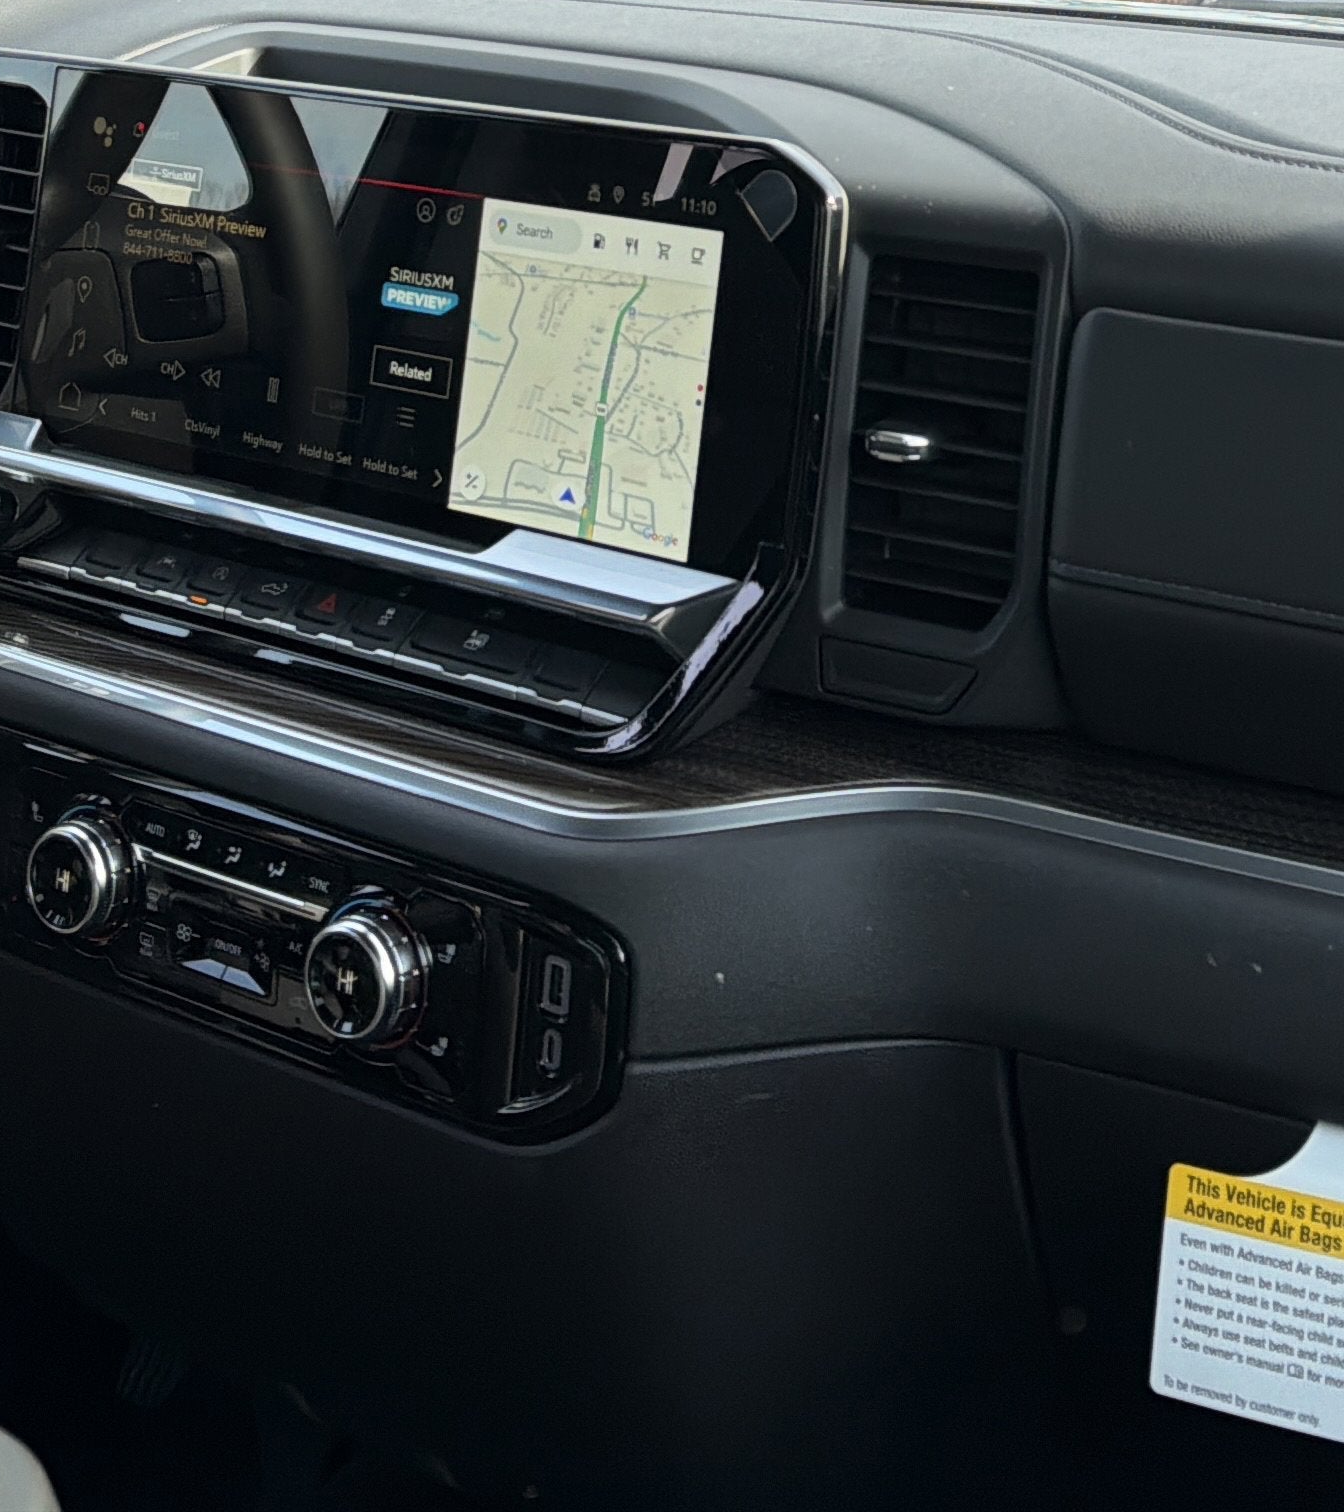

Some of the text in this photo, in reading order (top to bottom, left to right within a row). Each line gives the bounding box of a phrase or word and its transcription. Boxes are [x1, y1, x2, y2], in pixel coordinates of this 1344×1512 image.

[681, 197, 717, 216] 11:10
[127, 202, 145, 220] Ch
[159, 207, 214, 231] SiriusXM
[217, 216, 267, 239] Preview
[516, 223, 553, 240] Search
[125, 224, 153, 240] Great
[156, 229, 180, 245] Offer
[387, 288, 450, 310] PREVIEW
[161, 363, 174, 376] CH
[389, 360, 432, 382] Related
[131, 407, 149, 421] Hits
[242, 431, 283, 452] Highway
[299, 443, 322, 460] Hold
[336, 452, 352, 466] Set
[363, 457, 386, 474] Hold
[401, 466, 419, 481] Set
[643, 526, 678, 547] Google
[145, 822, 165, 838] AUTO
[309, 876, 330, 894] SYNC
[1187, 1175, 1220, 1199] This
[1226, 1183, 1286, 1215] Vehicle
[1291, 1199, 1305, 1219] is
[1184, 1198, 1343, 1252] Advanced Air Bags
[1180, 1233, 1344, 1285] Even with Advanced Air Bags
[1188, 1259, 1232, 1280] Children
[1235, 1273, 1255, 1287] can
[1258, 1276, 1272, 1290] be
[1275, 1280, 1306, 1299] killed
[1309, 1290, 1320, 1301] or
[1186, 1278, 1204, 1294] The
[1208, 1284, 1232, 1300] back
[1236, 1292, 1258, 1306] seat
[1272, 1300, 1289, 1315] the
[1292, 1306, 1324, 1323] safest
[1184, 1298, 1214, 1316] Never
[1217, 1307, 1234, 1321] put
[1246, 1315, 1305, 1341] rear-facing
[1307, 1329, 1334, 1345] child
[1182, 1318, 1218, 1338] Always
[1222, 1330, 1241, 1344] use
[1243, 1334, 1266, 1349] seat
[1268, 1339, 1295, 1356] belts
[1297, 1348, 1318, 1363] and
[1181, 1337, 1200, 1353] See
[1202, 1344, 1244, 1364] owner's
[1246, 1355, 1284, 1374] manual
[1307, 1369, 1323, 1383] for
[1164, 1374, 1175, 1388] To
[1177, 1378, 1188, 1392] be
[1191, 1384, 1233, 1405] removed
[1235, 1394, 1248, 1410] by
[1249, 1402, 1297, 1420] customer
